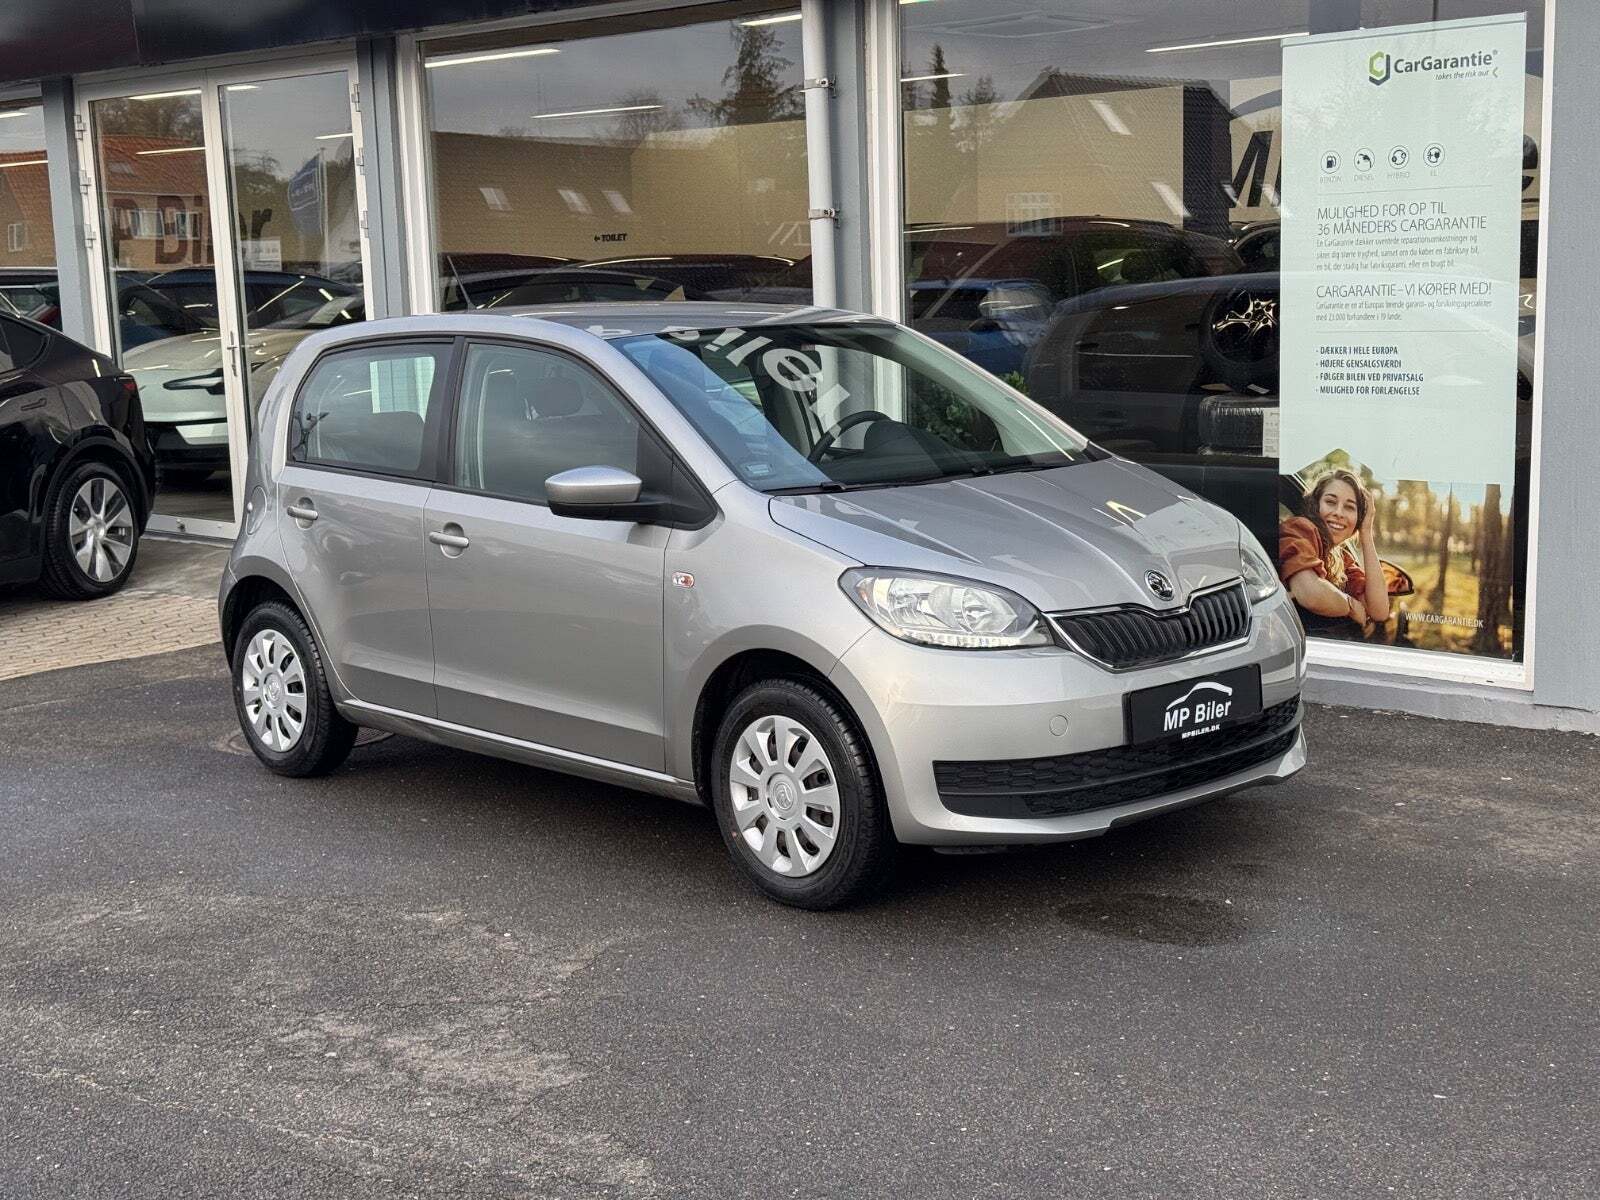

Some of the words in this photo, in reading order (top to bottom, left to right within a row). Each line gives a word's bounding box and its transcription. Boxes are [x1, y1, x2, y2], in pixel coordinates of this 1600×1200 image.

[1435, 71, 1452, 80] takes
[1453, 71, 1465, 79] the
[1465, 70, 1476, 78] risk
[1317, 204, 1379, 220] MULIGHED
[1382, 203, 1406, 217] FOR
[1408, 202, 1427, 216] OP
[1430, 201, 1447, 215] TIL
[1317, 223, 1330, 236] 36
[1333, 217, 1397, 235] MÅNEDERS
[1400, 216, 1487, 232] CARGARANTIE
[601, 233, 627, 242] TOILET
[1316, 283, 1397, 298] CARGARANTIE
[1405, 282, 1415, 296] VI
[1418, 282, 1457, 296] KØRER
[1459, 281, 1492, 296] MED!
[1320, 346, 1347, 355] DÆKKER
[1353, 346, 1370, 355] HELE
[1371, 346, 1398, 355] EUROPA
[1320, 359, 1345, 368] HØJERE
[1346, 359, 1402, 369] GENSALGSVÆRDI
[1320, 372, 1345, 381] FØLGER
[1346, 373, 1366, 381] BILEN
[1367, 373, 1381, 381] VED
[1382, 373, 1424, 382] PRIVATSALG
[1320, 386, 1354, 395] MULIGHED
[1356, 386, 1370, 394] FOR
[1371, 386, 1420, 396] FORLÆNGELSE
[1405, 611, 1484, 629] WWW.CARGARANTIE.DK
[1163, 707, 1190, 732] MP
[1194, 700, 1232, 724] Biler
[1181, 723, 1221, 739] MPBILER.DK
